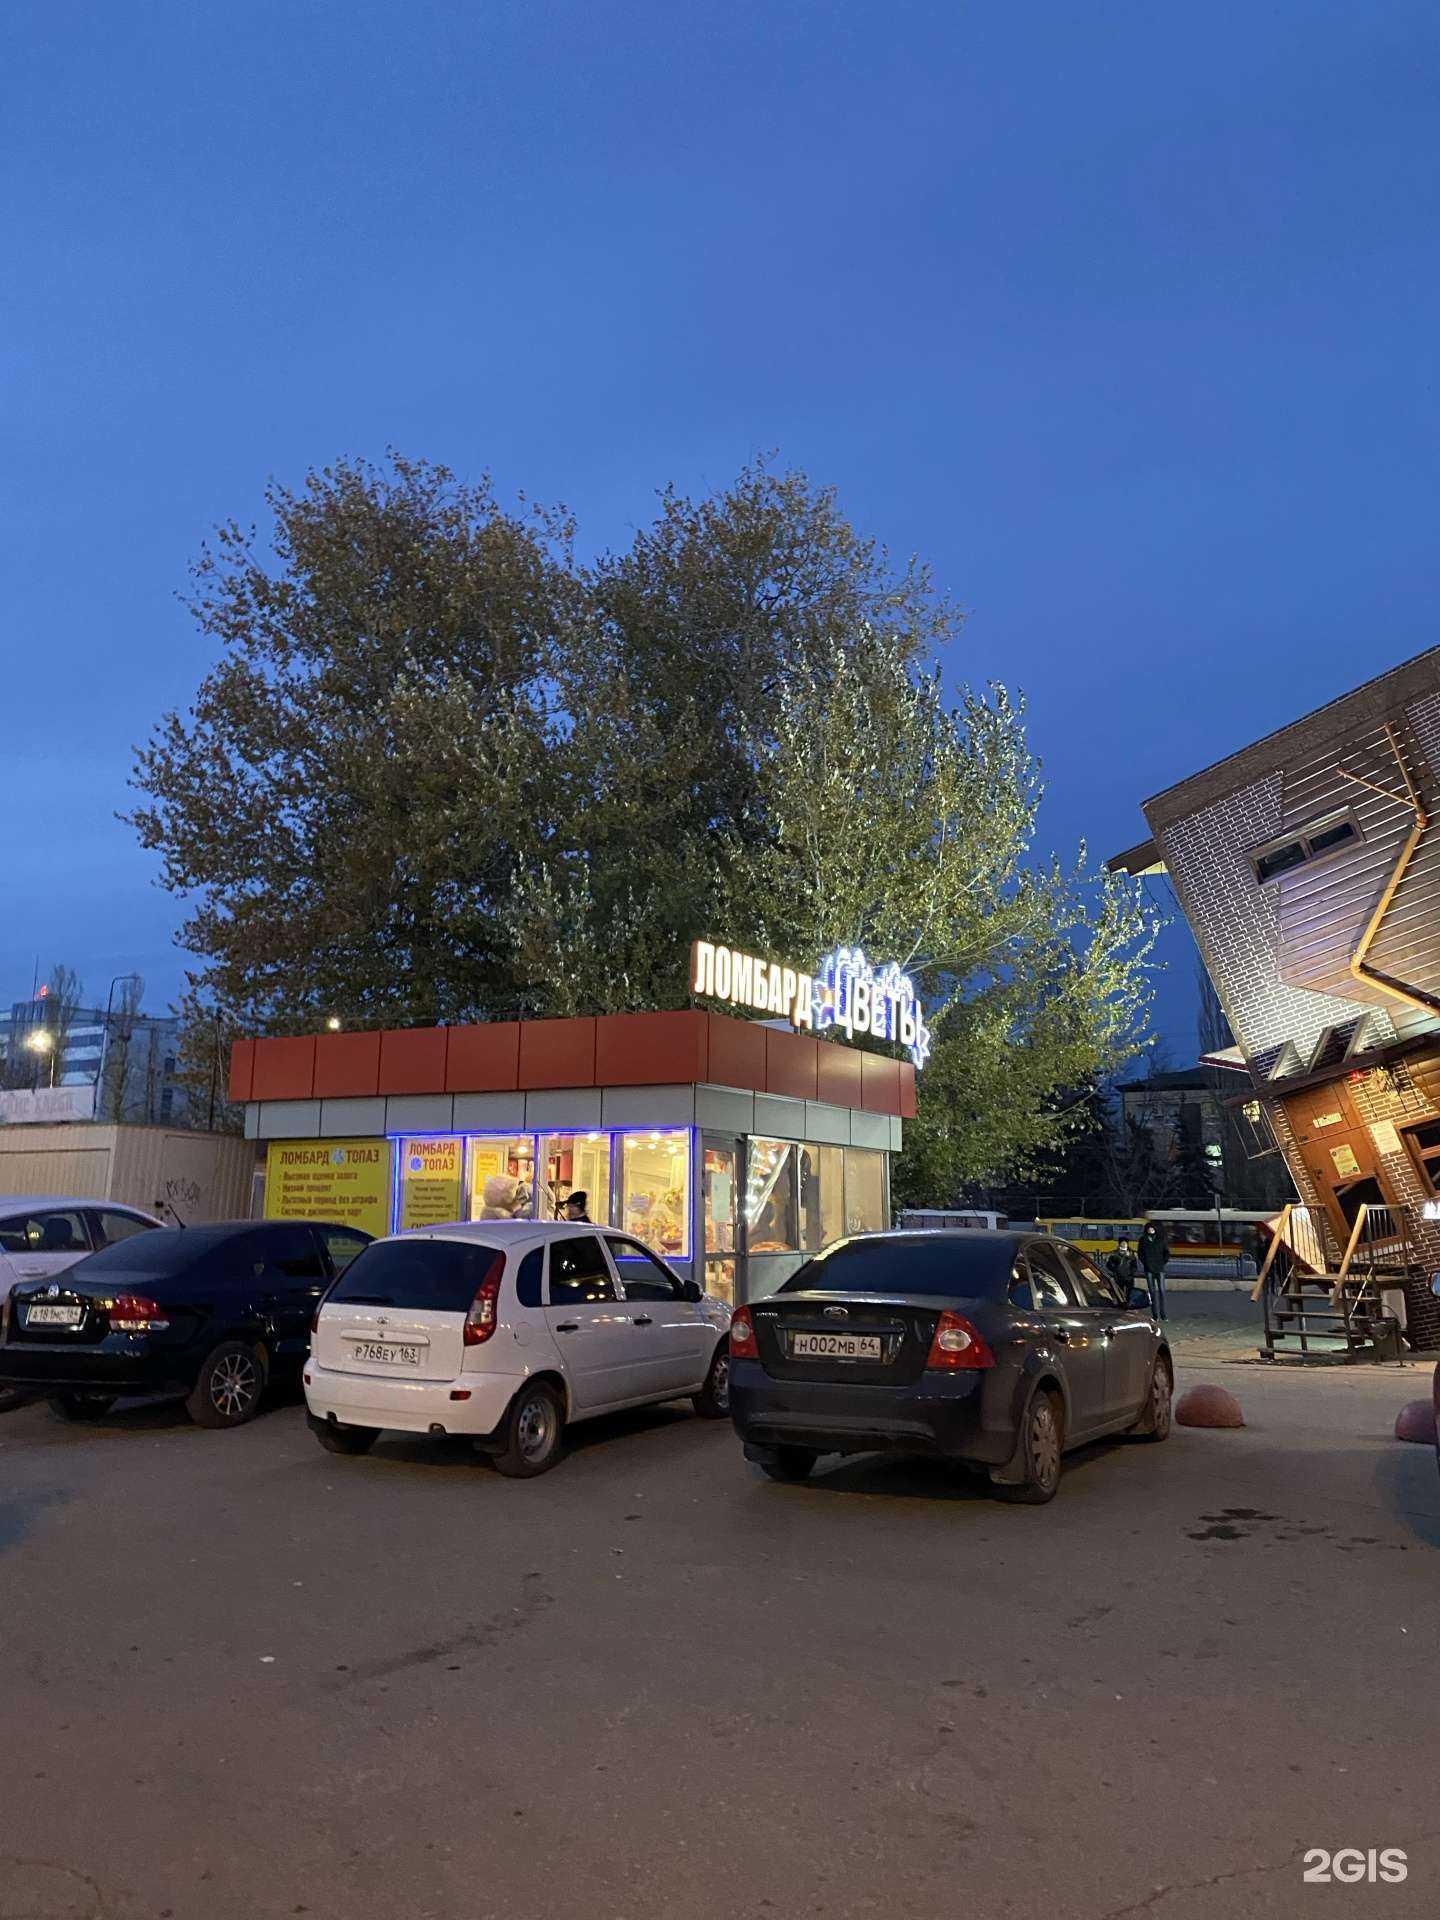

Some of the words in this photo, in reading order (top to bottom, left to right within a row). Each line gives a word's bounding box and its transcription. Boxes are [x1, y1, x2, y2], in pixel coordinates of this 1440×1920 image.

[694, 940, 813, 1030] ЛОМБАРД
[410, 1143, 456, 1156] ЛОМБАРД
[280, 1151, 329, 1166] ЛОМБАРД
[346, 1149, 380, 1163] ТОПАЗ
[423, 1158, 455, 1171] ТОПАЗ
